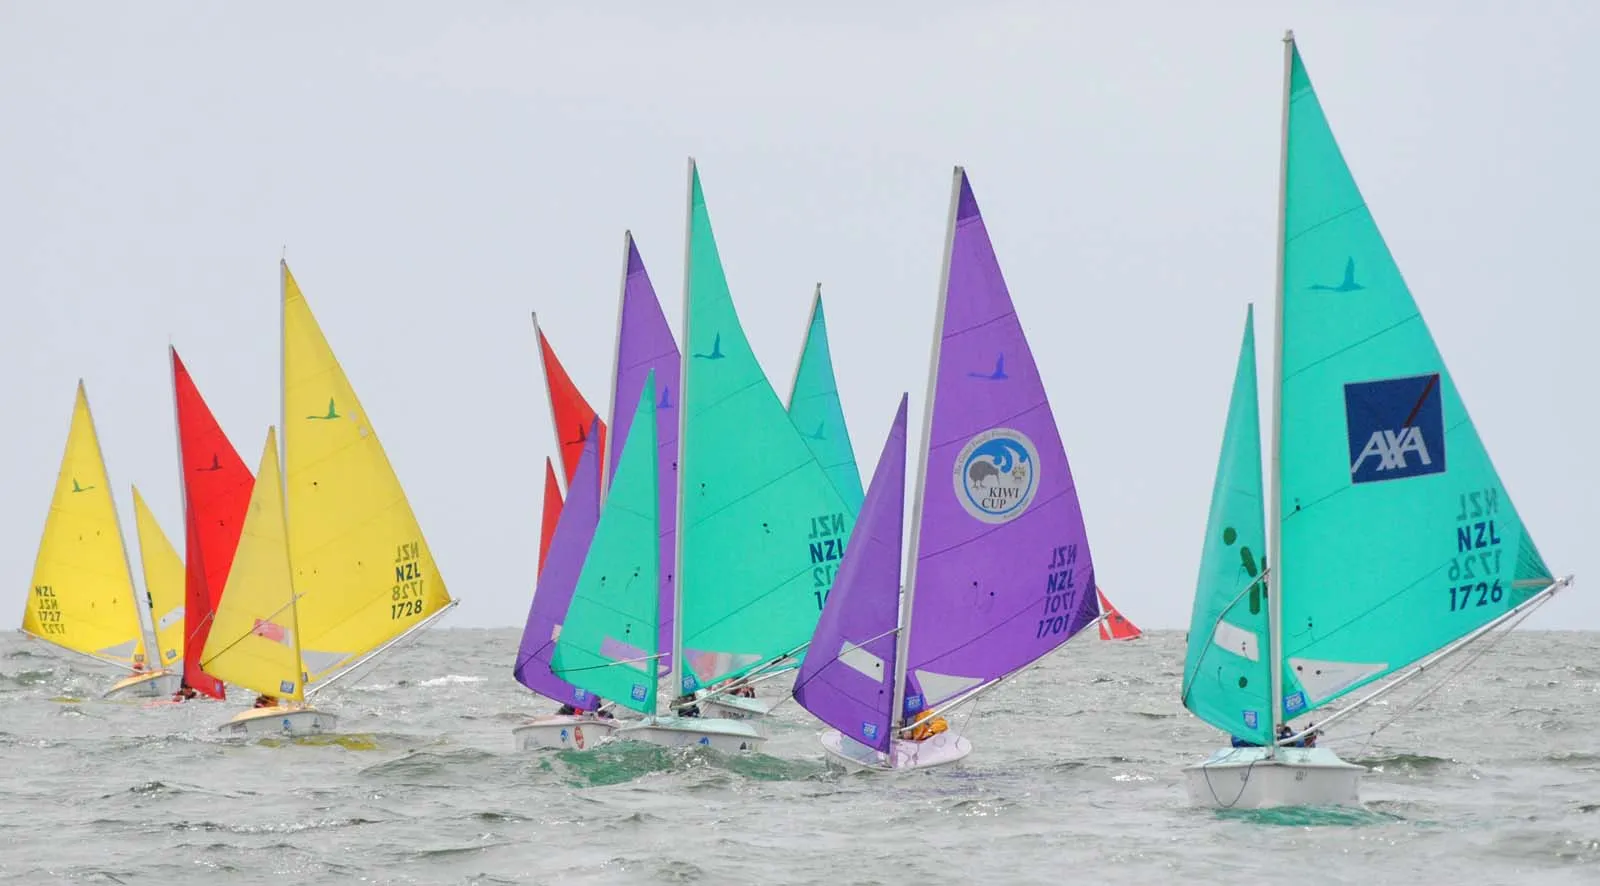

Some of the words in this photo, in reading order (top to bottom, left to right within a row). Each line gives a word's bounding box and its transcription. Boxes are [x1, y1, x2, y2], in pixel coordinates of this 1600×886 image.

[1350, 426, 1432, 473] AXA
[982, 498, 1006, 509] CUP
[989, 487, 1020, 499] KIWI
[1457, 520, 1501, 553] NZL
[396, 562, 421, 583] NZL
[1046, 569, 1074, 594] NZL
[35, 586, 56, 597] NZL
[1449, 579, 1503, 612] 1726
[38, 610, 61, 622] 1727
[391, 599, 423, 620] 1728
[1036, 614, 1070, 639] 1701
